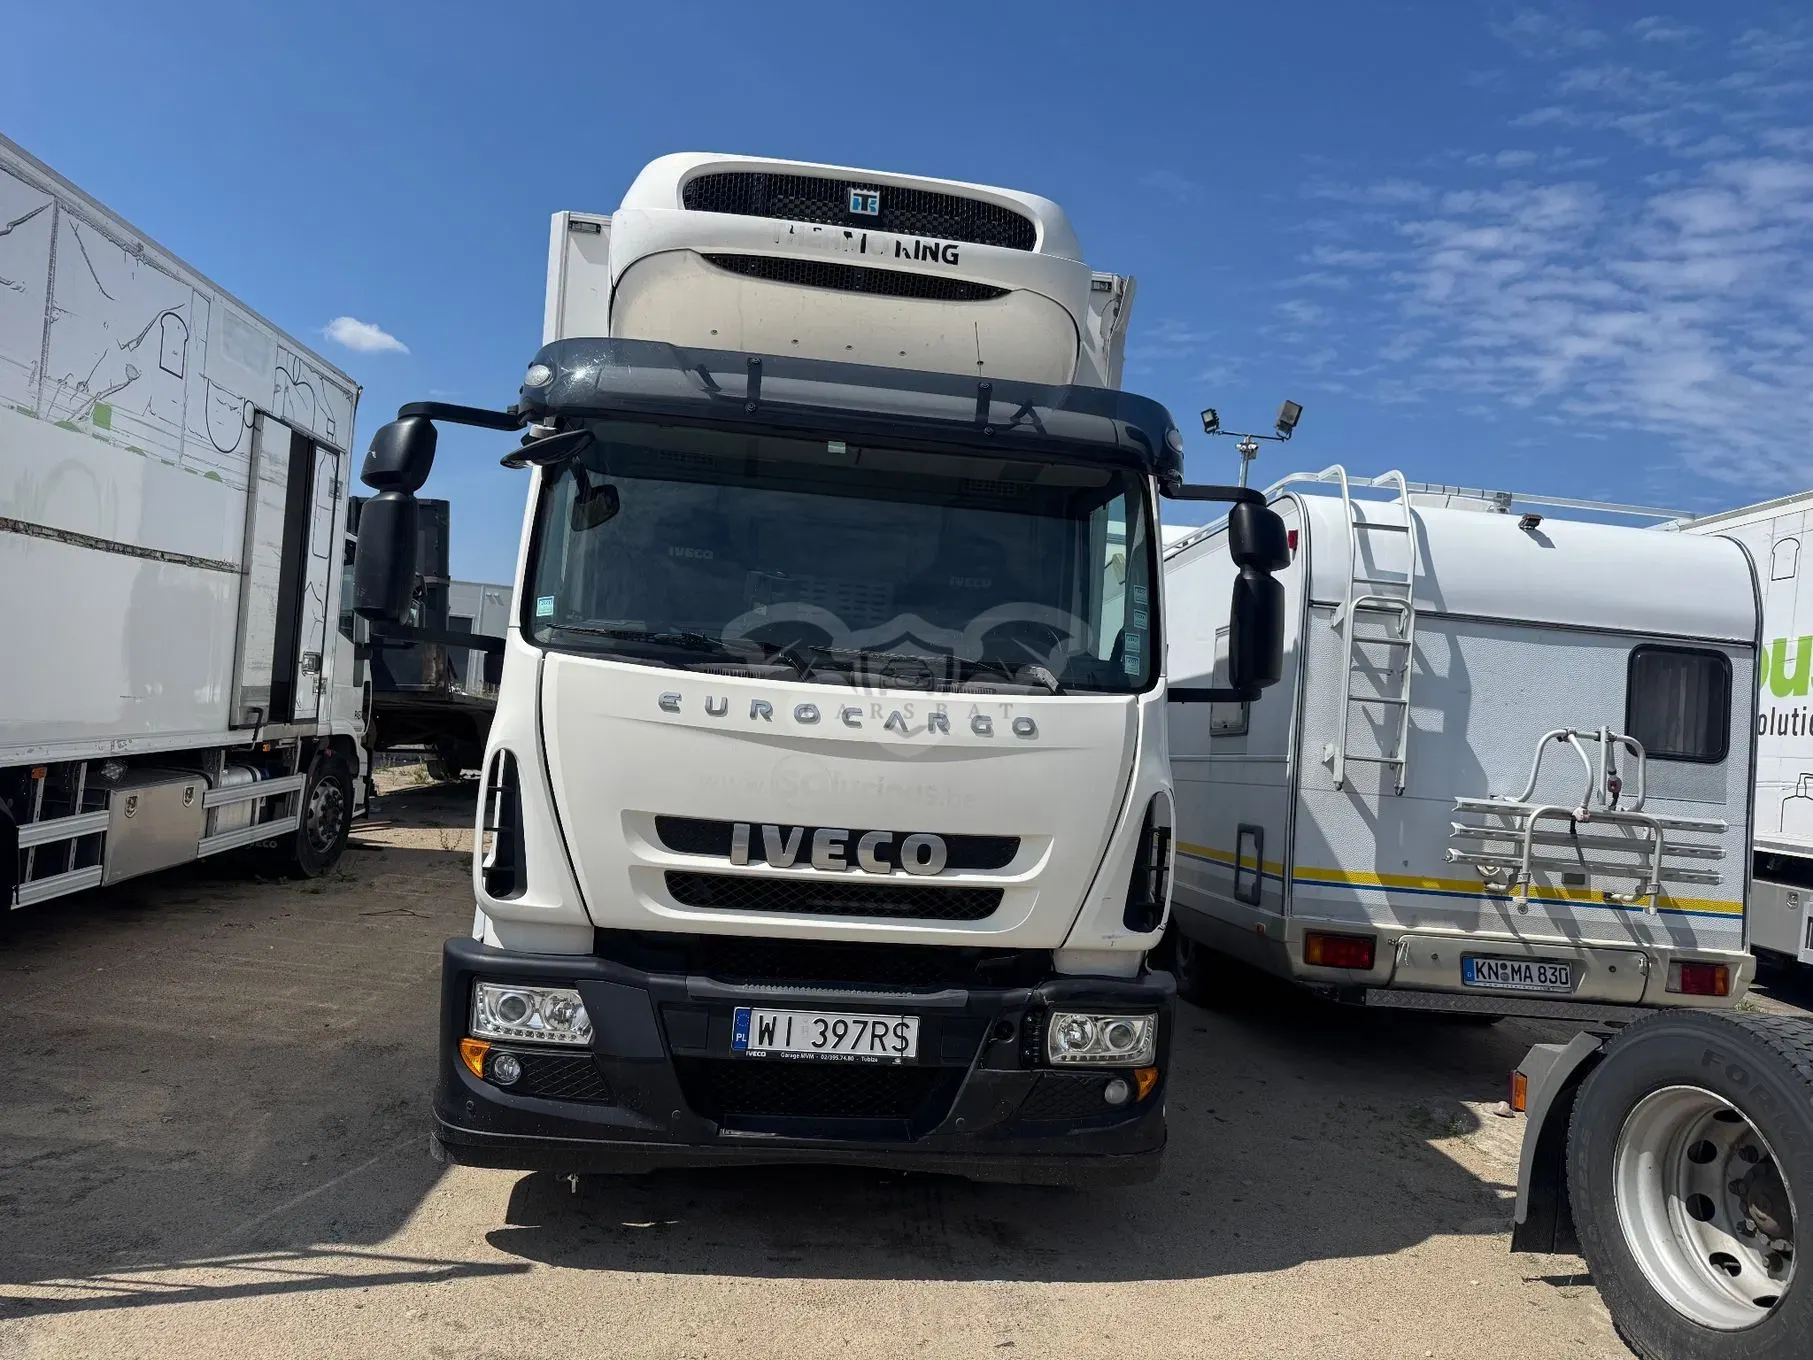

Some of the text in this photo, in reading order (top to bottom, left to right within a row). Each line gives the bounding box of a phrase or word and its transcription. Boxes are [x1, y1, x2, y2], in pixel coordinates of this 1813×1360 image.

[658, 691, 1039, 740] EUROCARGO
[730, 823, 947, 875] IVECO
[1475, 961, 1568, 985] KN MA 830
[736, 1033, 747, 1042] PL
[758, 1015, 910, 1052] WI 397RS
